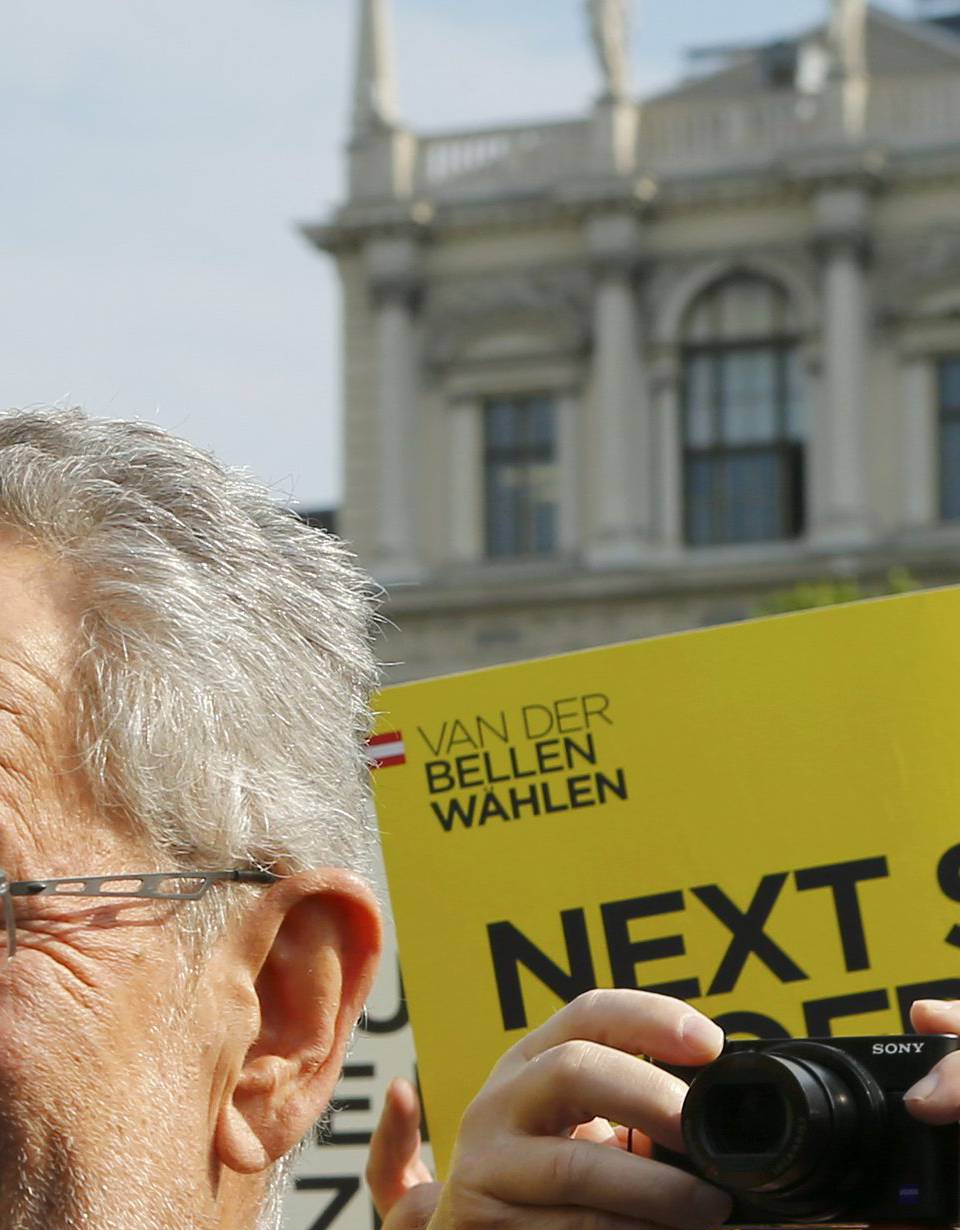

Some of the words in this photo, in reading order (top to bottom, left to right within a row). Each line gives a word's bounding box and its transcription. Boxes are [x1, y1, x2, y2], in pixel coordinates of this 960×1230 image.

[417, 710, 509, 757] VAN
[521, 692, 614, 740] DER
[424, 732, 597, 795] BELLEN
[430, 767, 628, 832] WÄHLEN
[485, 855, 890, 1031] NEXT
[872, 1042, 925, 1055] SONY
